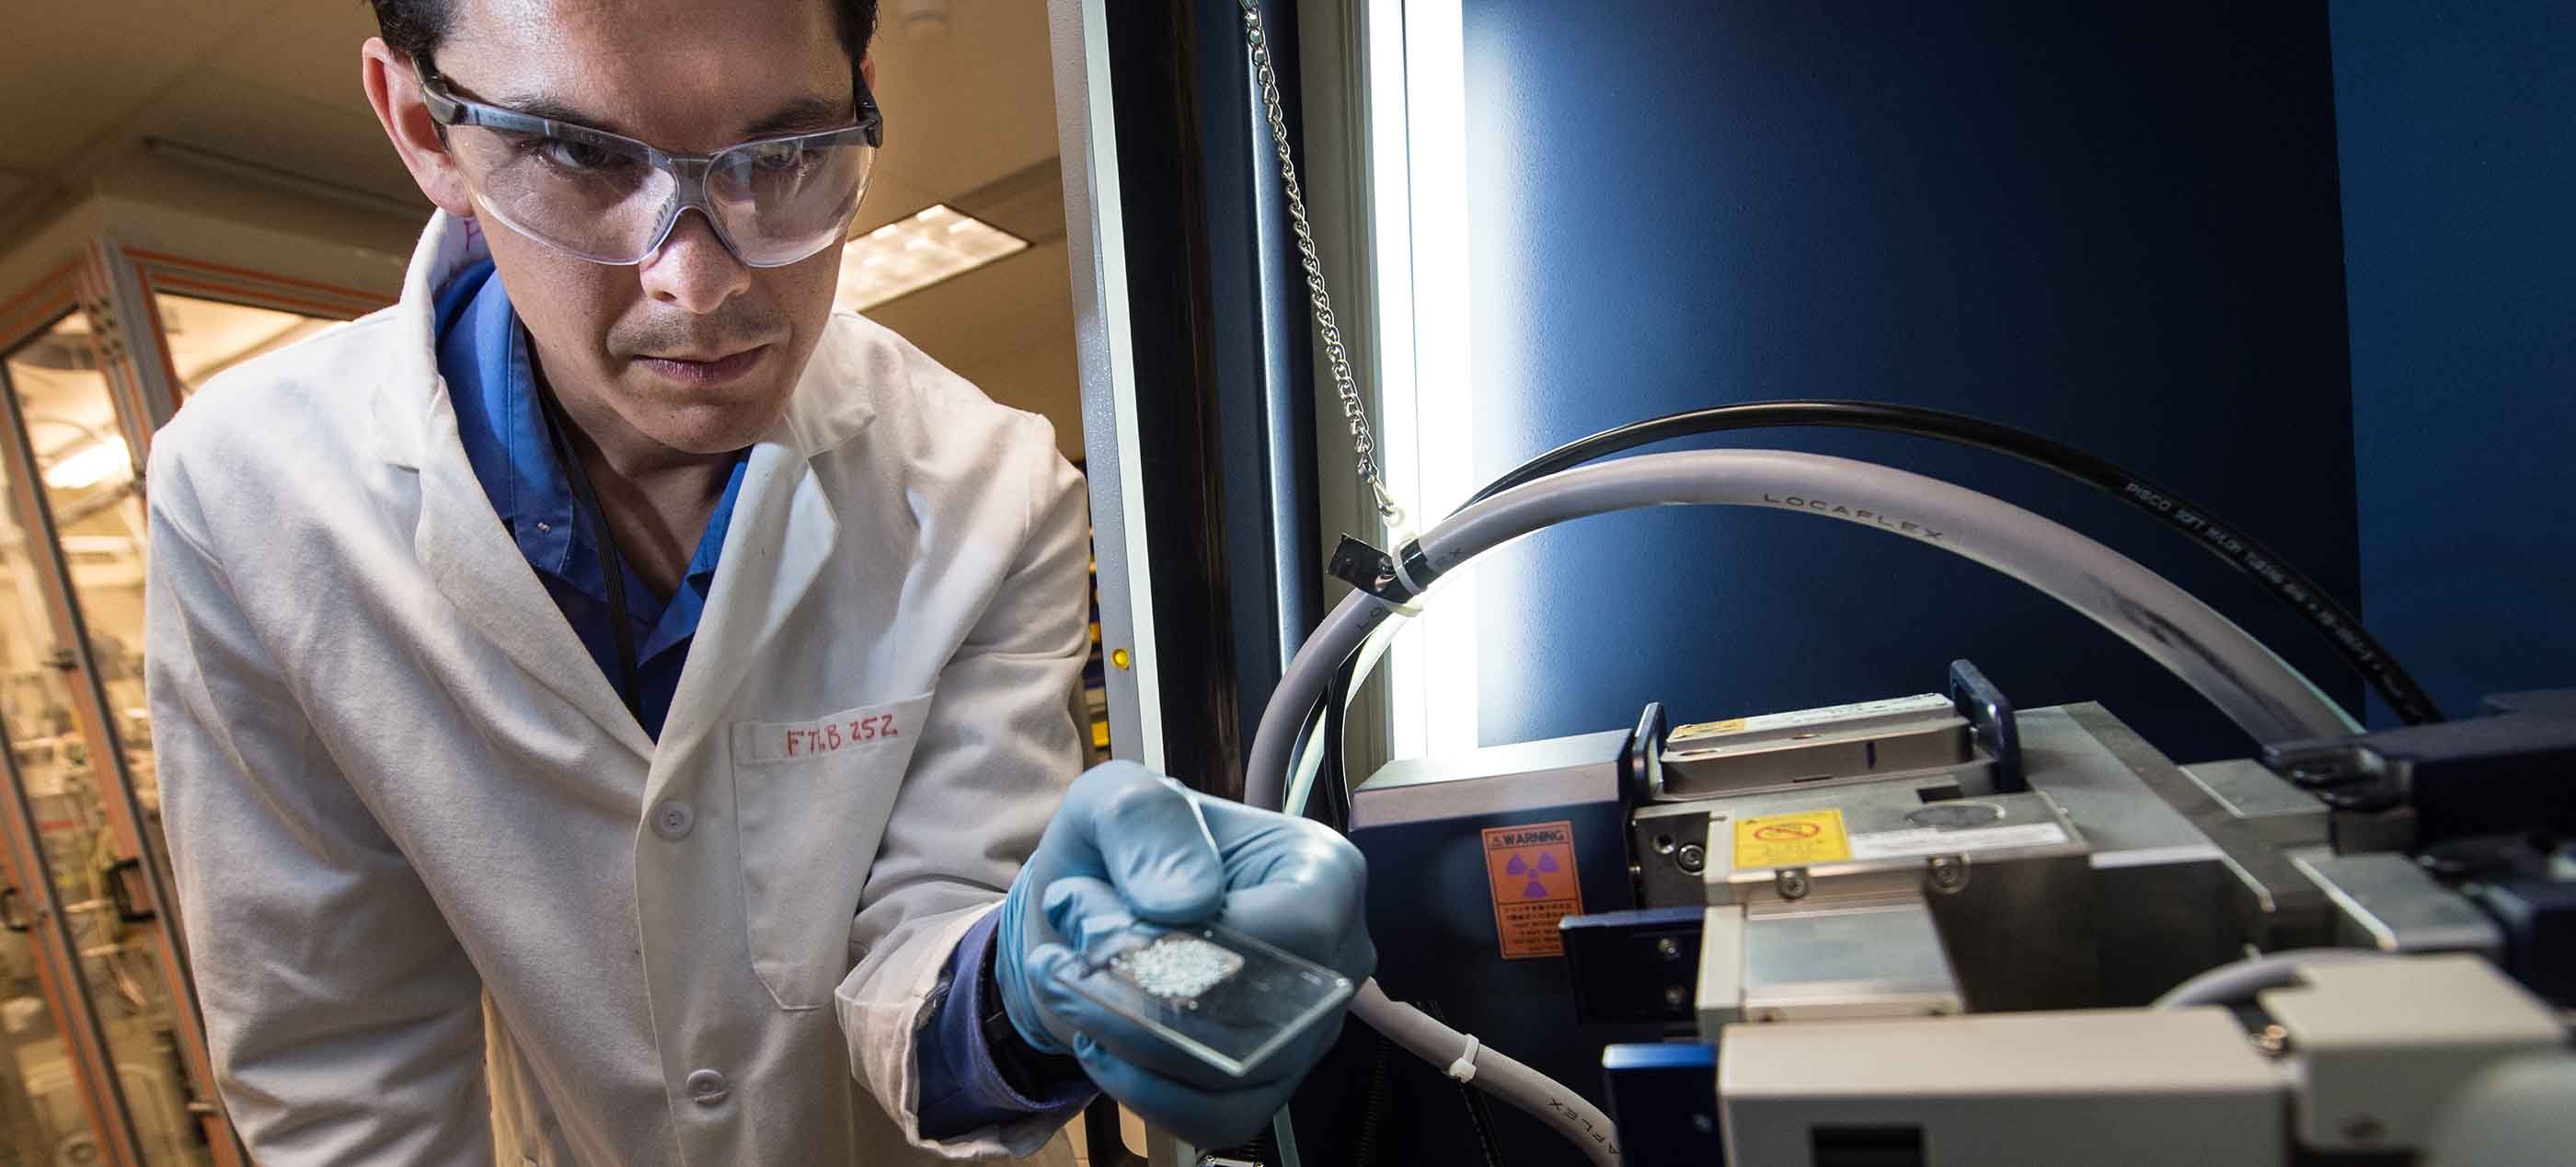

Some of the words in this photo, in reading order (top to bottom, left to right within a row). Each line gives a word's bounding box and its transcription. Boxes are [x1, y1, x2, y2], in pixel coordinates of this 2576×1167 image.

[2126, 482, 2172, 511] PISCO
[1764, 492, 1944, 539] LOCAFLEX
[849, 713, 899, 742] 252
[1502, 830, 1564, 845] WARNING
